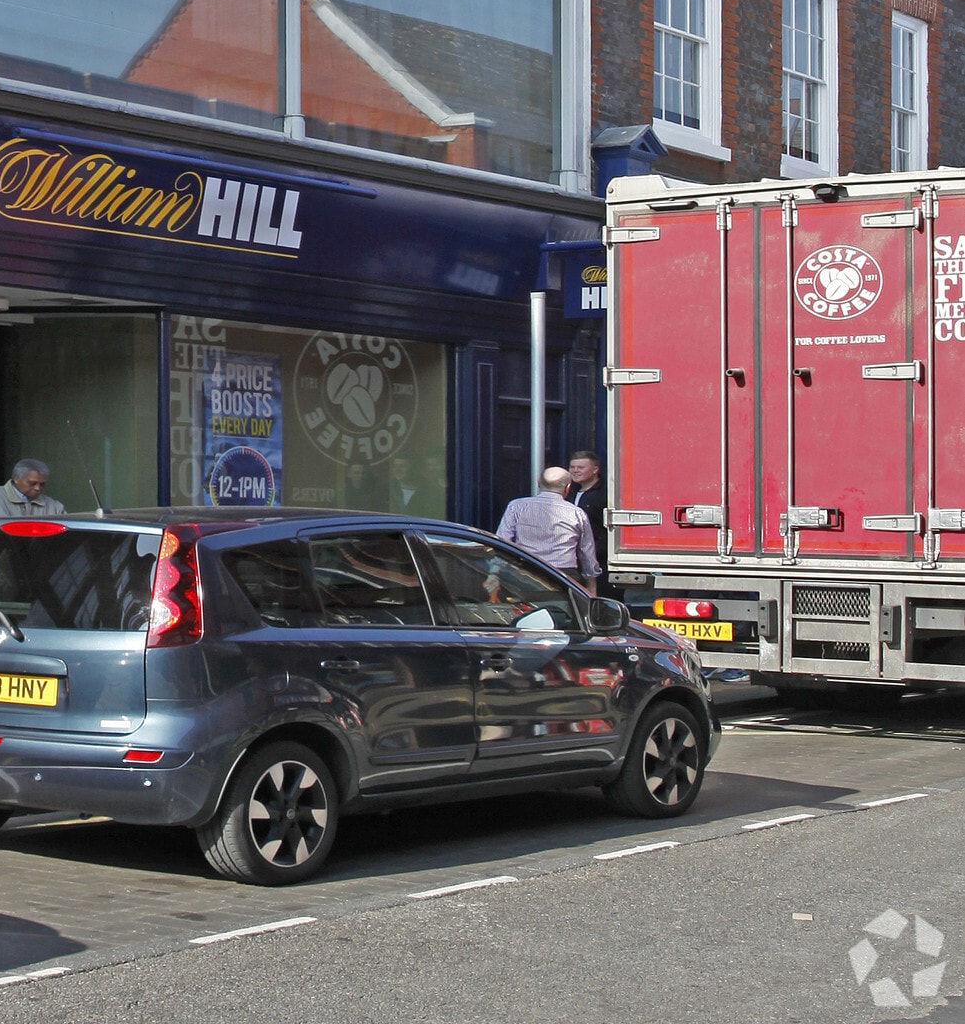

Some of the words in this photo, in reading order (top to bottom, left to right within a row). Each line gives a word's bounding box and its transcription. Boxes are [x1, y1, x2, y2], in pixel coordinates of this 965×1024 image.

[197, 176, 302, 249] HILL
[806, 248, 868, 271] COSTA
[865, 274, 878, 282] 1971
[935, 275, 965, 302] F
[803, 289, 876, 317] COFFEE
[795, 337, 813, 346] FOR
[814, 336, 848, 345] COFFEE
[850, 334, 886, 344] LOVERS
[225, 363, 273, 392] PRICE
[211, 389, 273, 417] BOOSTS
[212, 415, 247, 435] EVERY
[251, 418, 273, 437] DAY
[218, 476, 266, 499] 12-1PM
[692, 624, 722, 638] HXV
[8, 677, 48, 699] HNY
